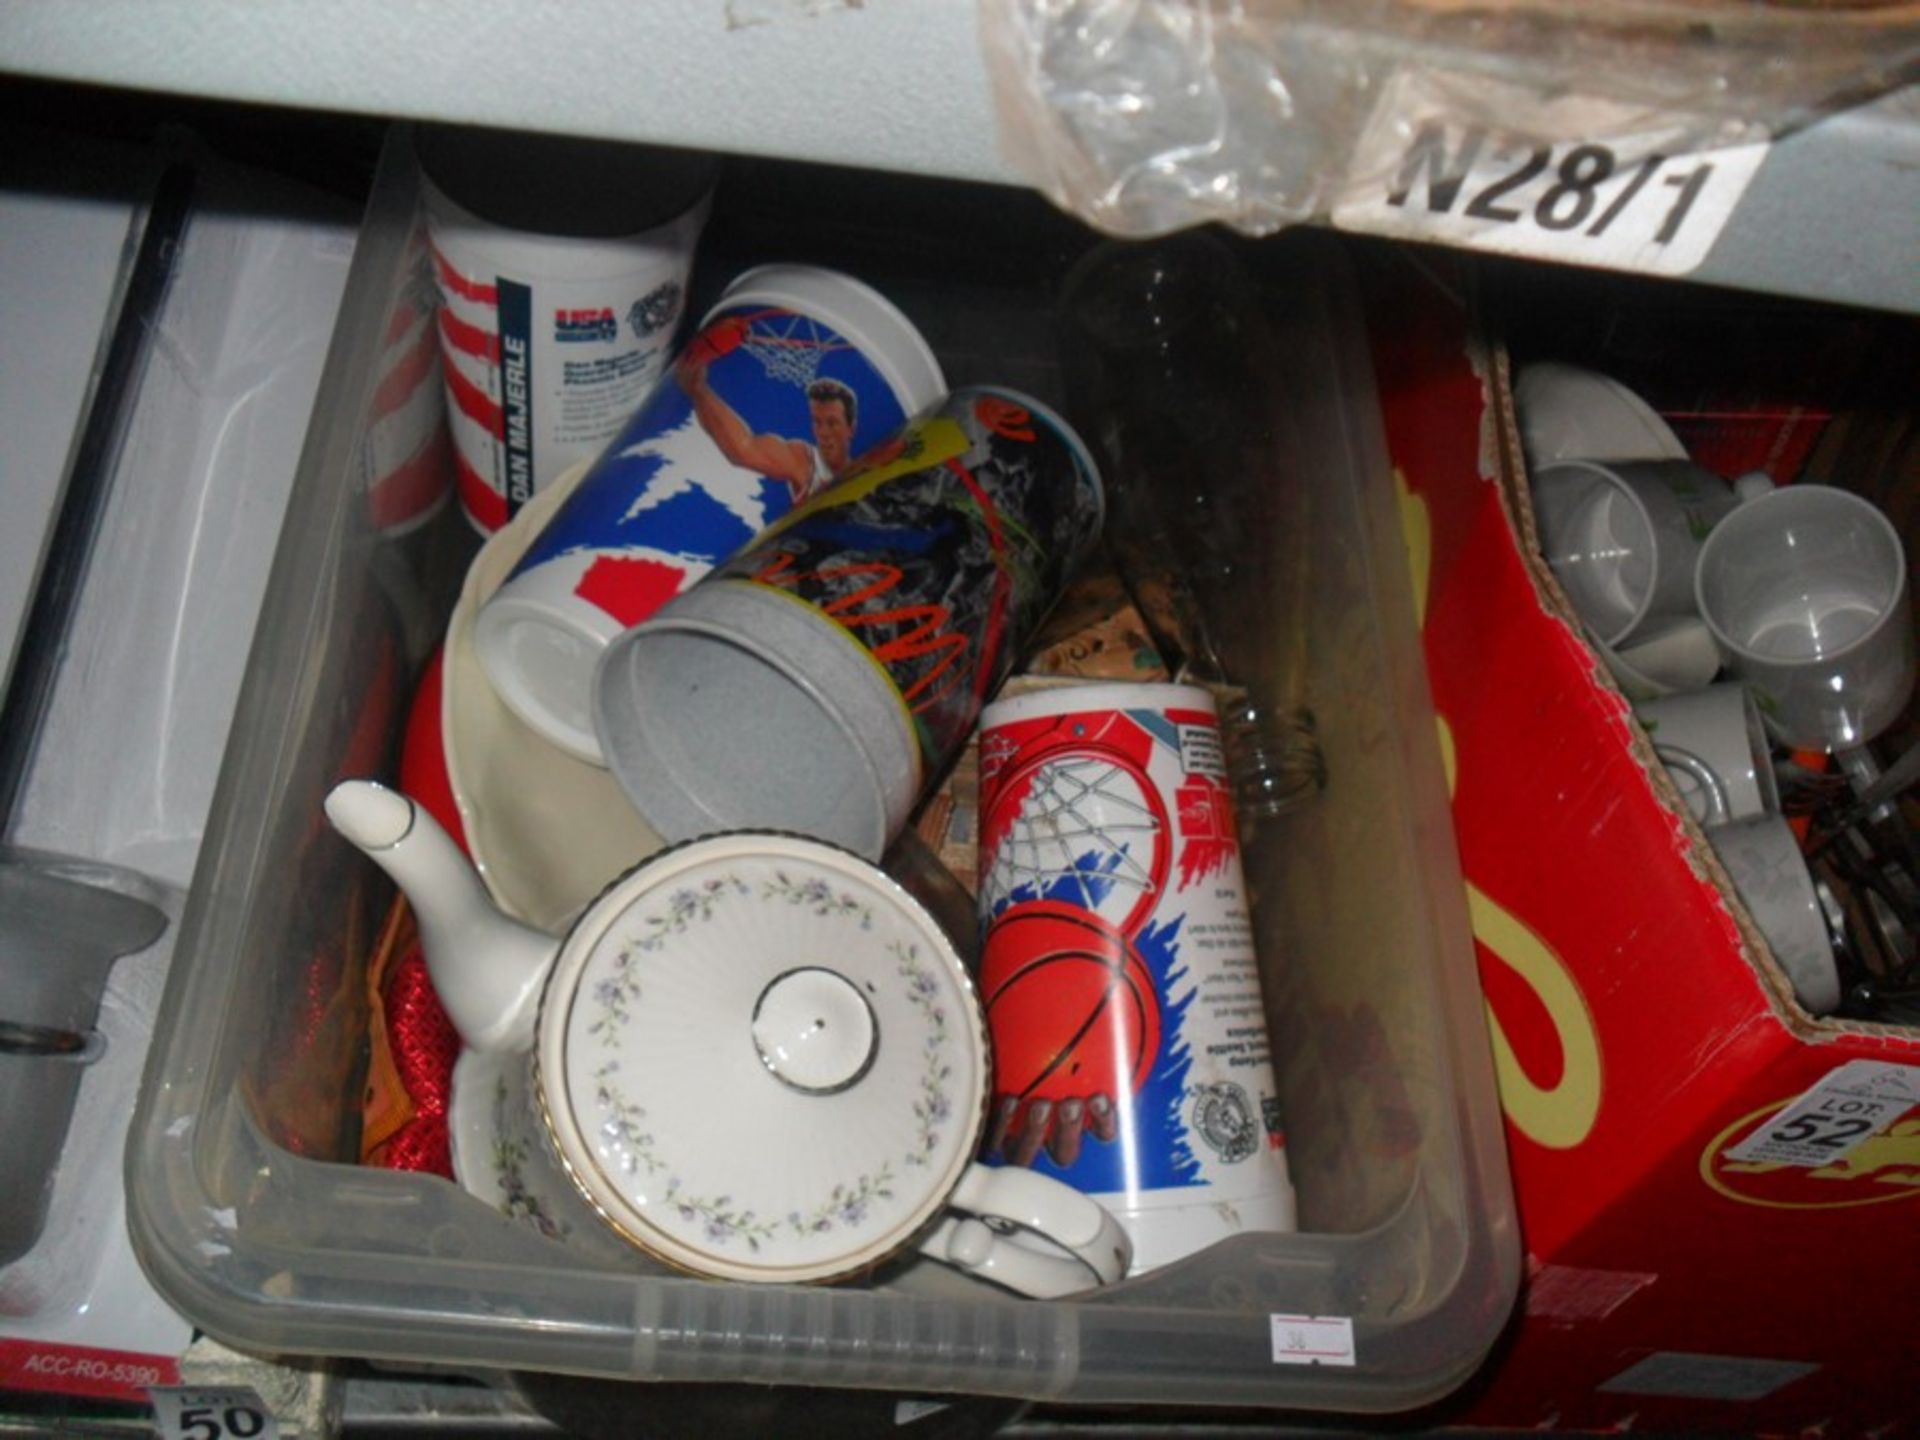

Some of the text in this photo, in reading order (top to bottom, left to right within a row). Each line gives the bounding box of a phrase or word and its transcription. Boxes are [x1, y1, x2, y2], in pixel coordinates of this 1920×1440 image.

[1386, 120, 1715, 246] N28/1
[505, 335, 530, 502] DAN MAJERLE
[1771, 1113, 1872, 1148] 52
[24, 1354, 161, 1385] ACC-RO-5390
[179, 1406, 265, 1440] 50
